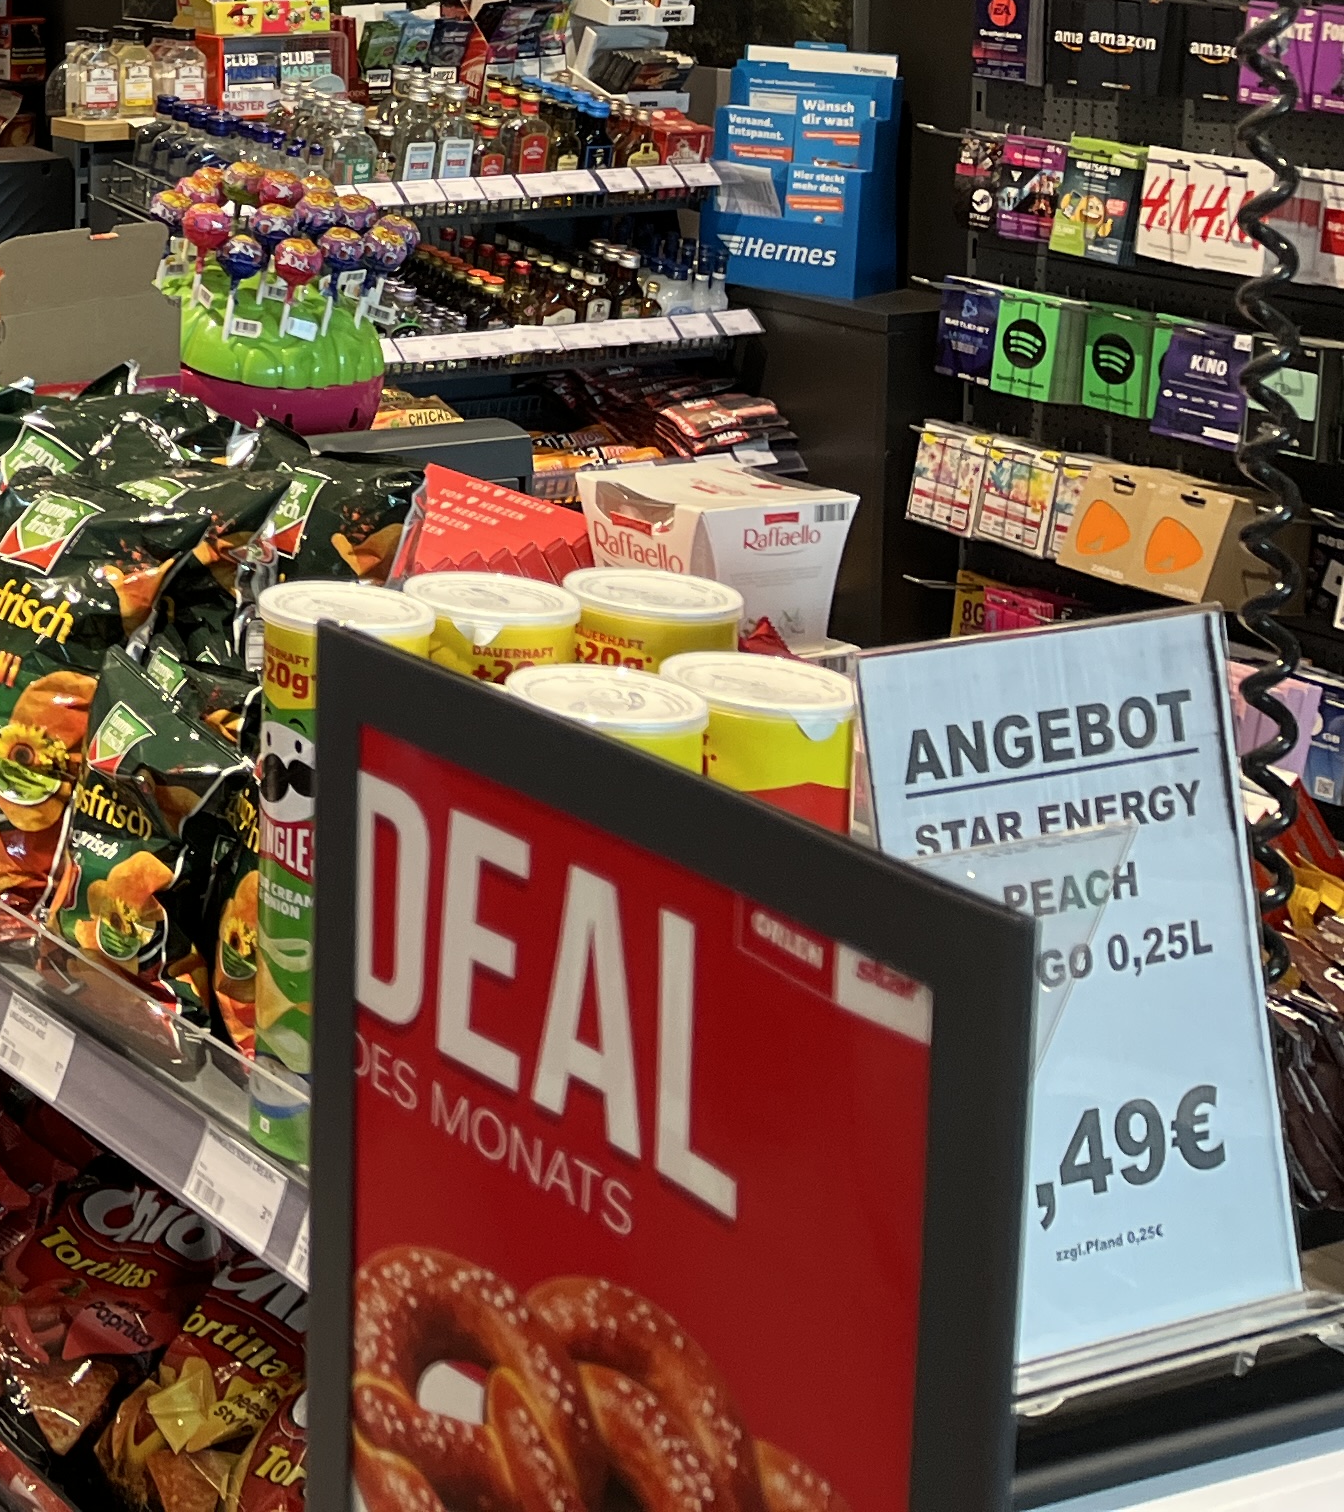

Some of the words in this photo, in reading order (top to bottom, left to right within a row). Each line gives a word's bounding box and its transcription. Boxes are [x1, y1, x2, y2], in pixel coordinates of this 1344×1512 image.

[992, 3, 1012, 15] EA
[1089, 31, 1156, 50] amazon
[280, 51, 314, 66] CLUB
[280, 64, 331, 79] MASTER
[860, 67, 887, 75] Hermes
[802, 99, 855, 113] Wünsch
[728, 114, 774, 128] Versand.
[802, 114, 822, 125] dir
[824, 116, 854, 127] was!
[728, 125, 784, 141] Entspannt.
[792, 182, 818, 192] mehr
[819, 183, 843, 194] drin.
[793, 170, 814, 181] Hier
[816, 173, 846, 184] steckt
[744, 238, 837, 267] Hermes
[1190, 354, 1227, 375] KINO
[440, 487, 465, 500] VON
[480, 499, 527, 522] HERZEN
[451, 505, 500, 527] HERZEN
[595, 522, 684, 572] Raffaello
[743, 524, 821, 551] Raffaello
[472, 644, 554, 659] DAUERHAFT
[904, 689, 1193, 786] ANGEBOT
[914, 811, 1023, 856] STAR
[1038, 780, 1202, 836] ENERGY
[1003, 861, 1138, 919] PEACH
[751, 910, 824, 970] ORLEN
[1109, 920, 1214, 981] 0,25L
[355, 769, 739, 1223] DEAL
[429, 1079, 634, 1236] MONATS
[1126, 1224, 1164, 1246] 0,25€
[41, 1226, 157, 1289] Tortillas
